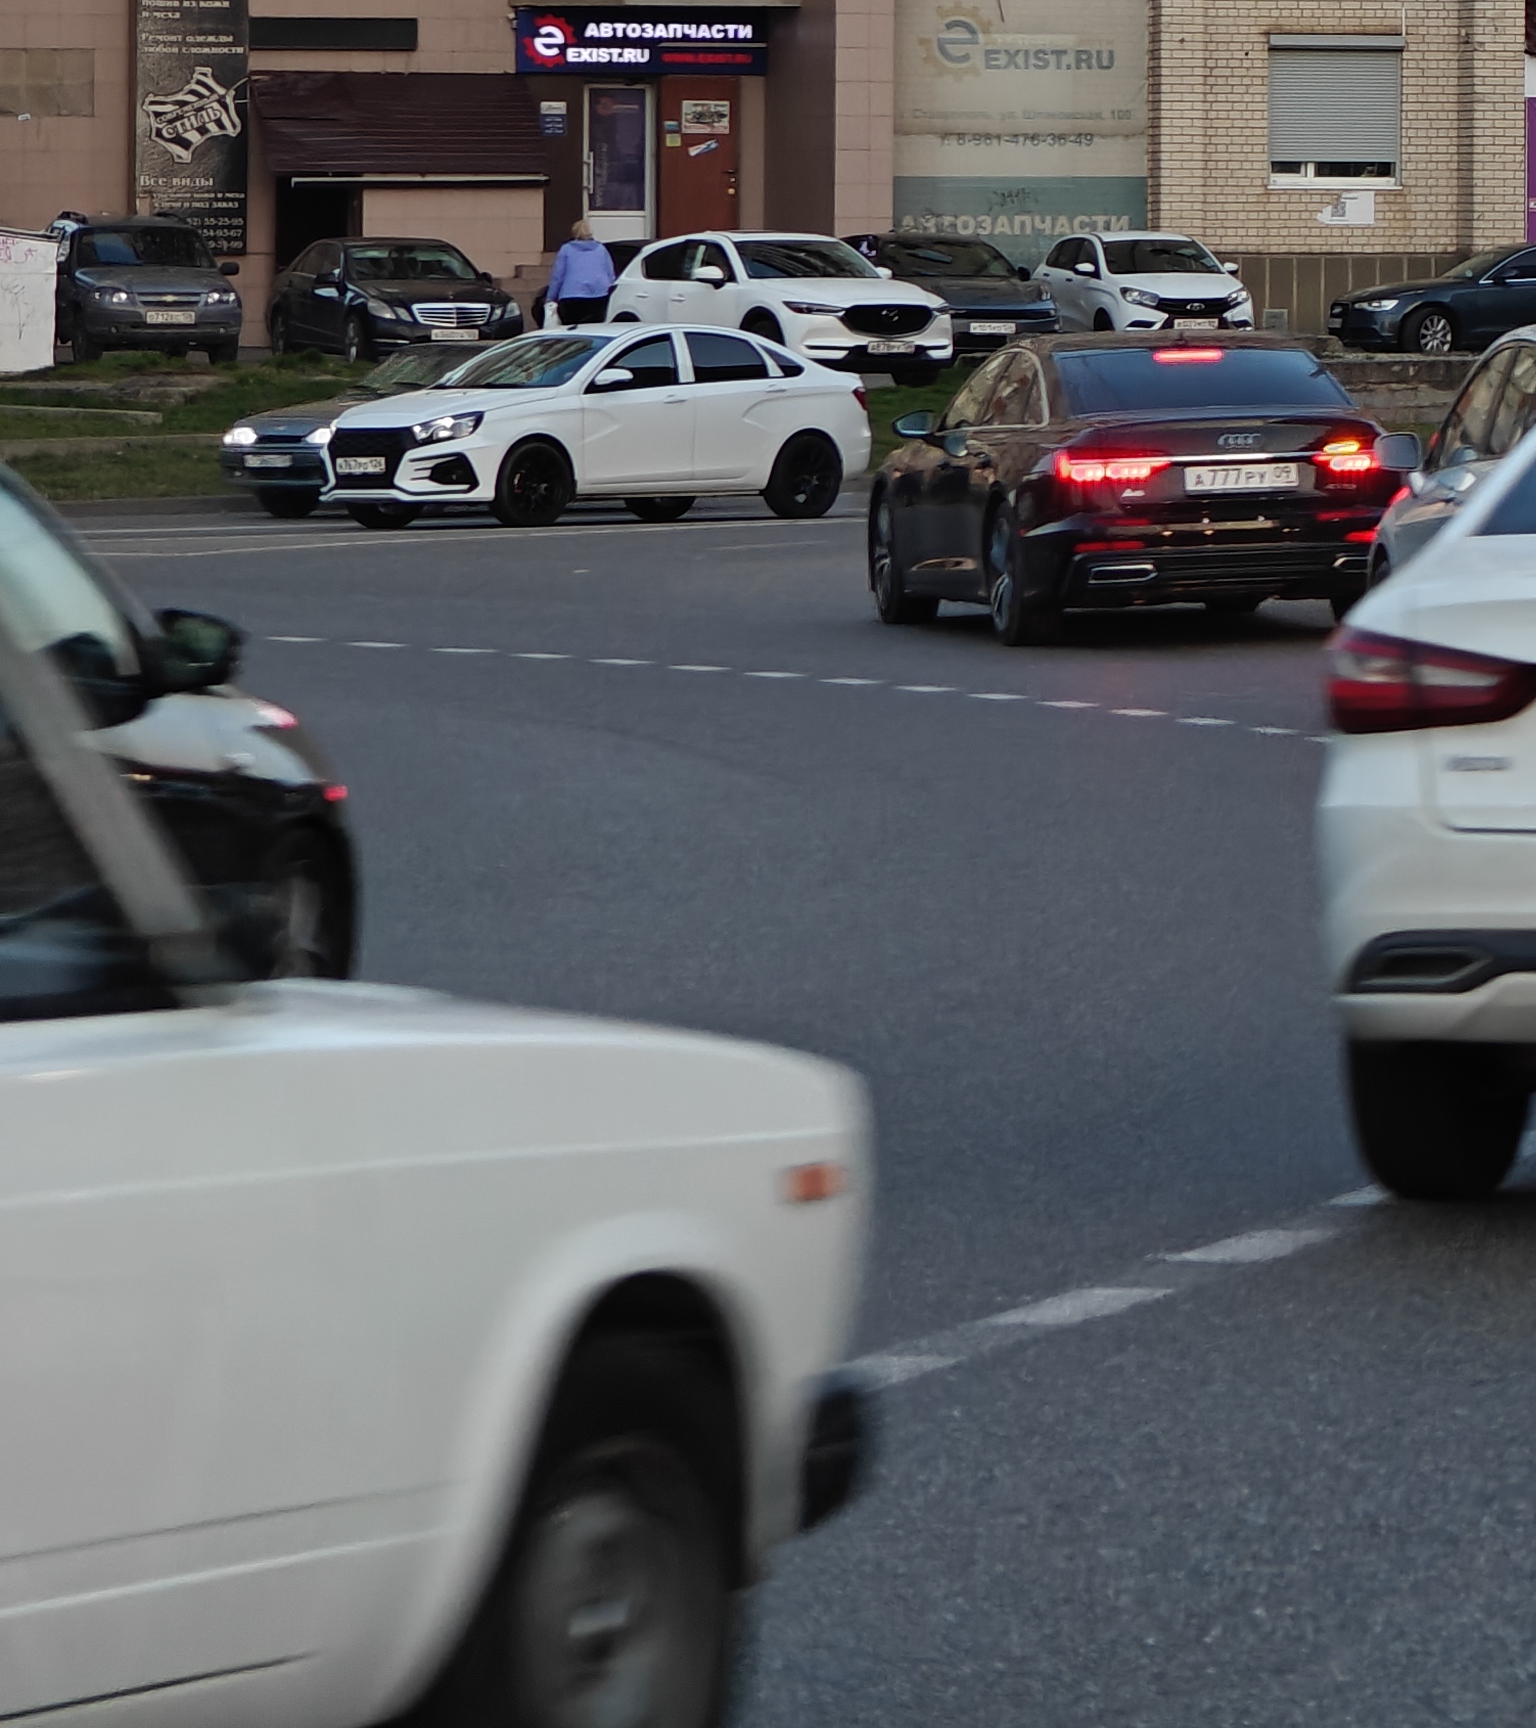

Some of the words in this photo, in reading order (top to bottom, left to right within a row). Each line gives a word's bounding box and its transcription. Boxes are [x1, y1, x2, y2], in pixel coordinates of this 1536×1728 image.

[585, 22, 753, 39] АВТОЗАПЧАСТИ
[566, 47, 650, 63] EXIST.RU
[984, 49, 1115, 70] EXIST.RU
[901, 215, 1131, 236] АВТОЗАПЧАСТИ
